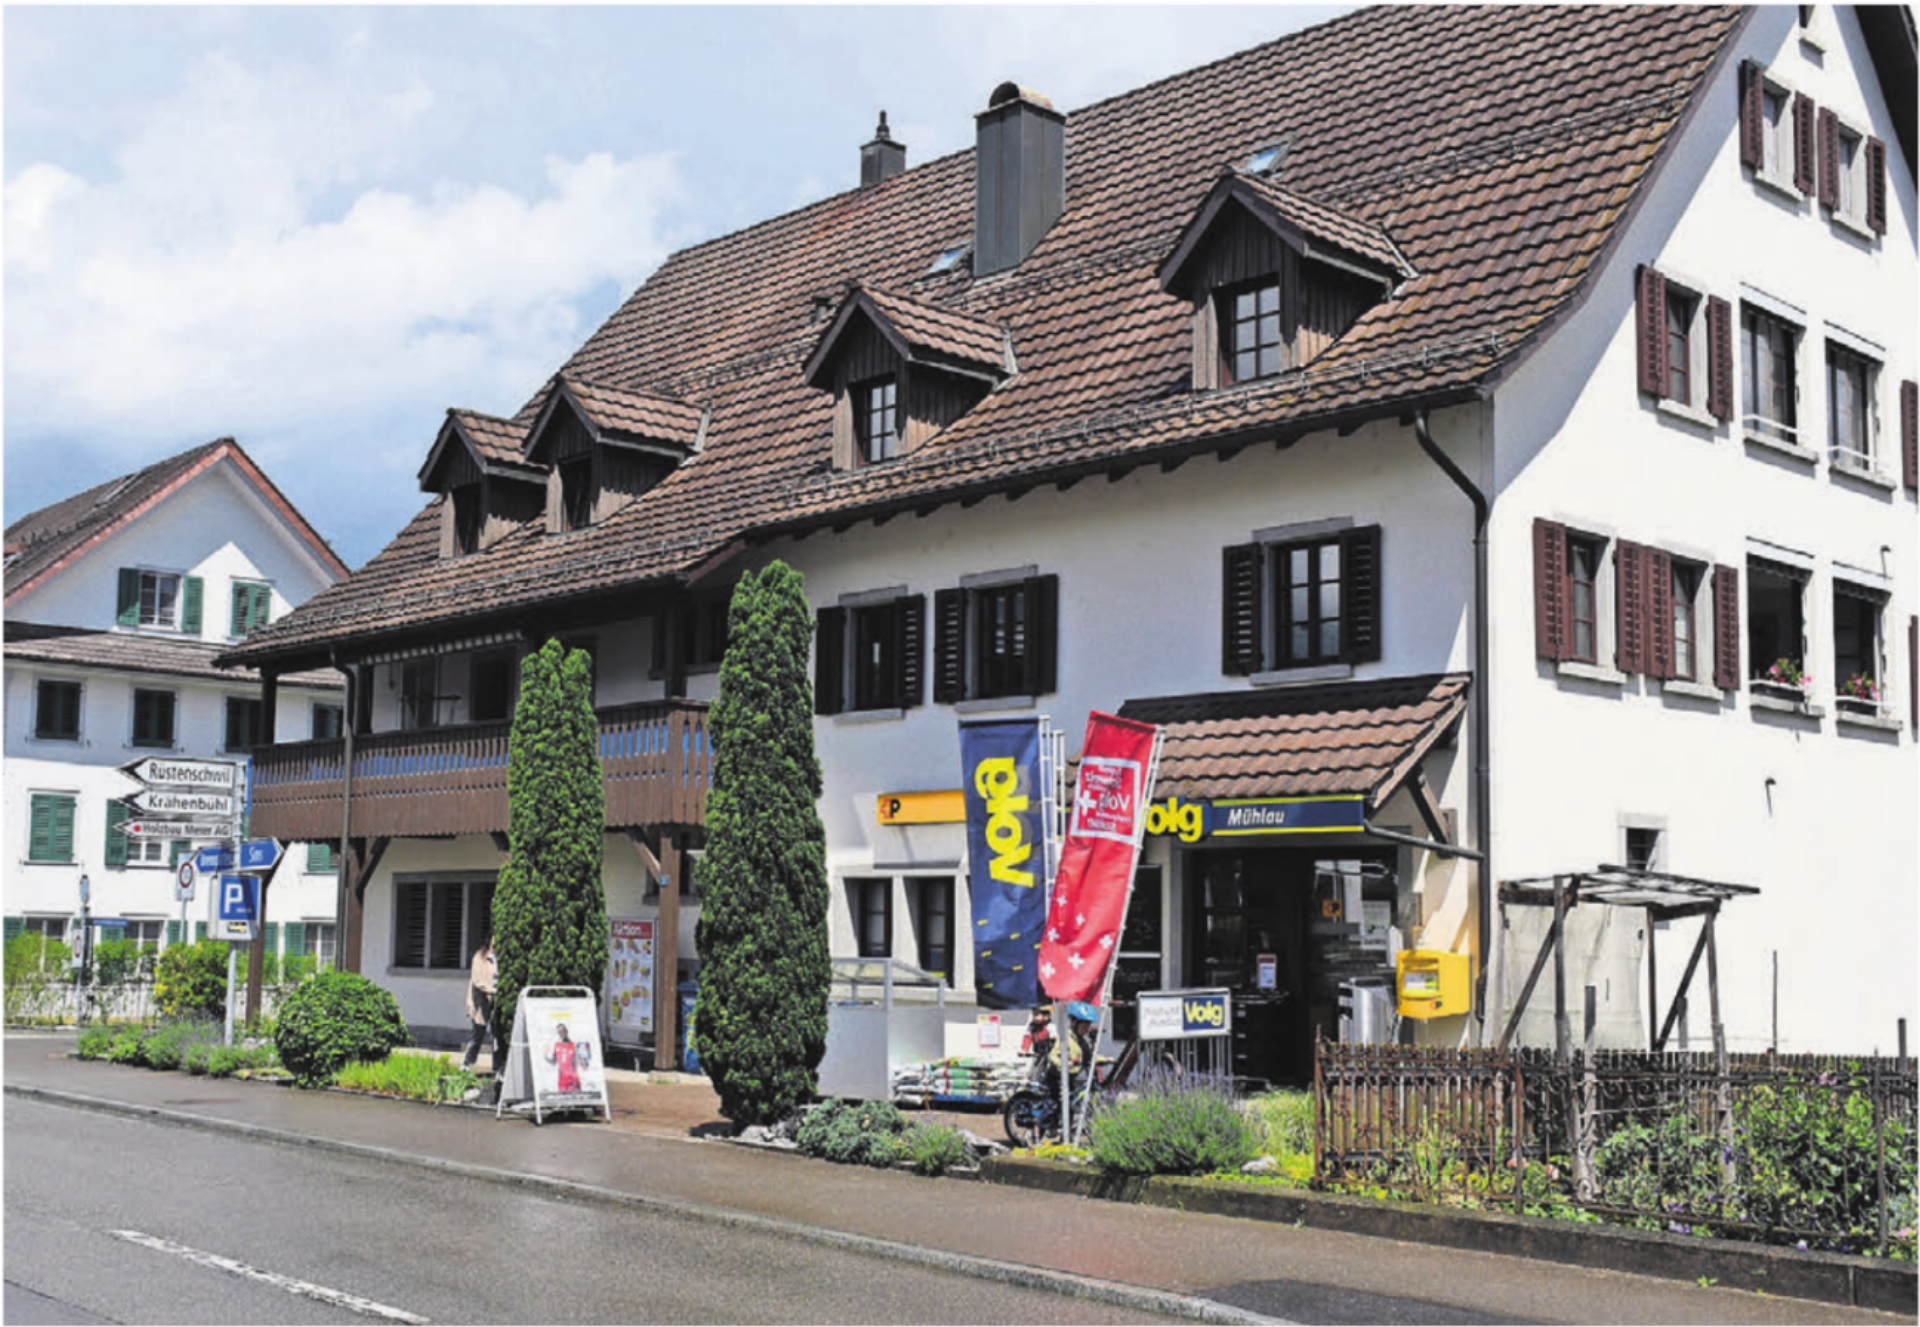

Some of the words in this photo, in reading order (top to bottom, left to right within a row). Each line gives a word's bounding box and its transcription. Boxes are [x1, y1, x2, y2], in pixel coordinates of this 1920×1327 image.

[149, 762, 231, 784] Rüstenschwil
[148, 795, 228, 811] Krähenbühl
[1144, 796, 1203, 842] olg
[1228, 807, 1285, 826] Mühlau
[223, 883, 244, 914] P
[1184, 1000, 1224, 1026] Volg
